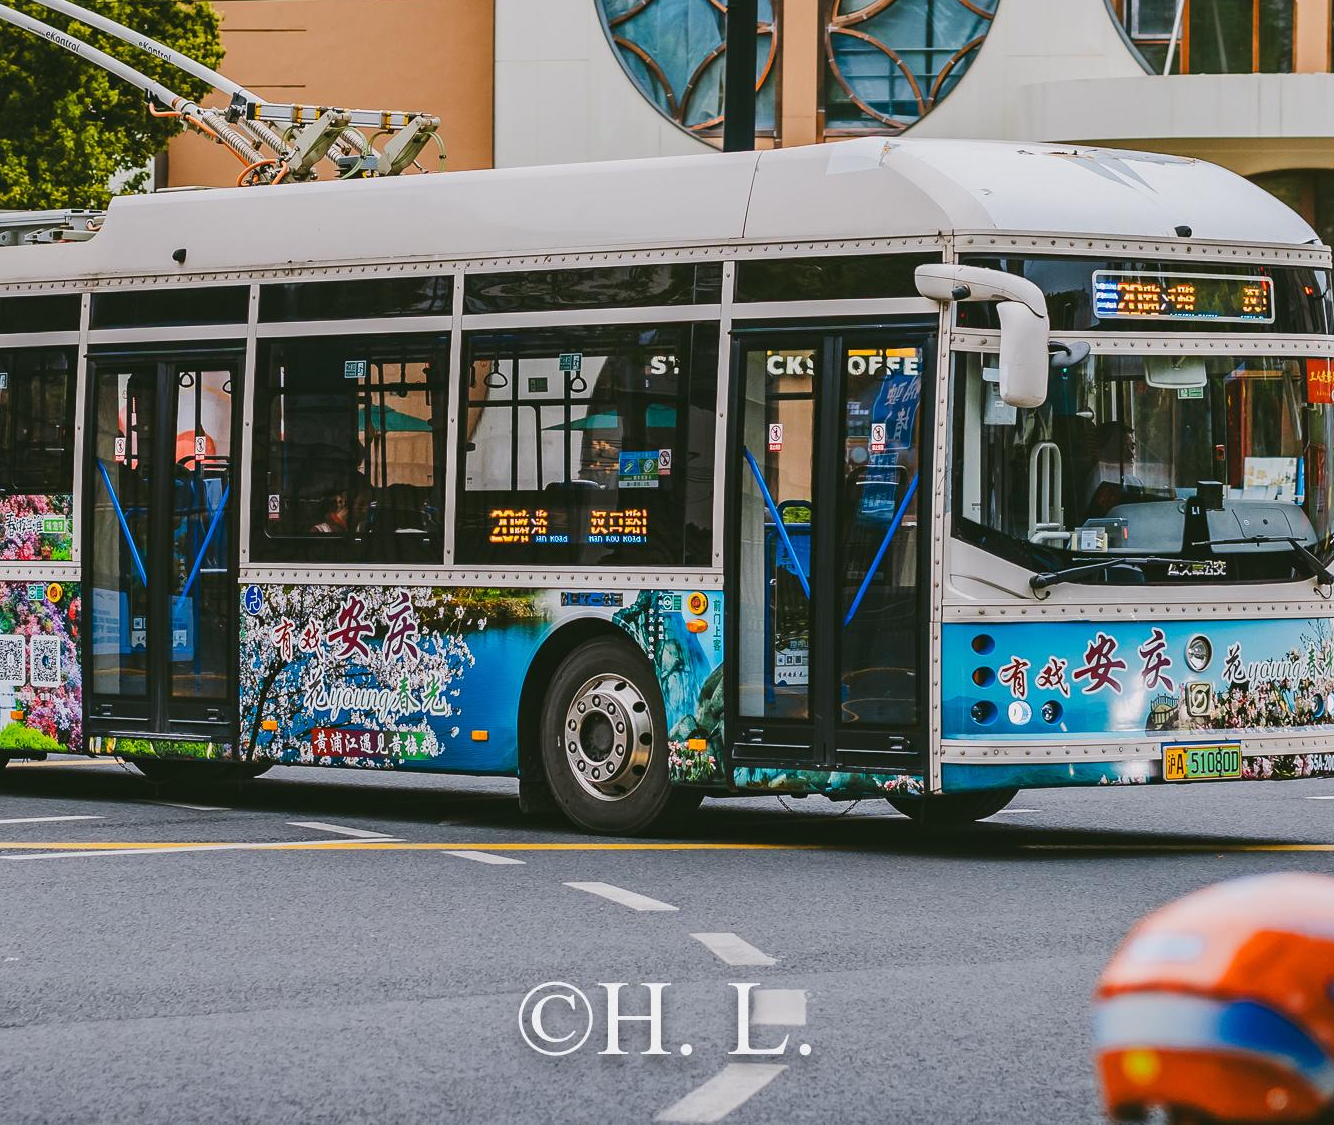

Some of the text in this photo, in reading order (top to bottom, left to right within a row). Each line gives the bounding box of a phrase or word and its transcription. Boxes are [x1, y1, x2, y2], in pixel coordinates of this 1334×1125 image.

[274, 592, 418, 662] 有戏安庆
[712, 599, 724, 652] 前门上客
[999, 629, 1175, 696] 有戏安庆
[304, 669, 446, 722] 花young春光
[313, 733, 439, 757] 黄浦江遇见黄梅戏
[1166, 749, 1239, 777] 沪A 51080D
